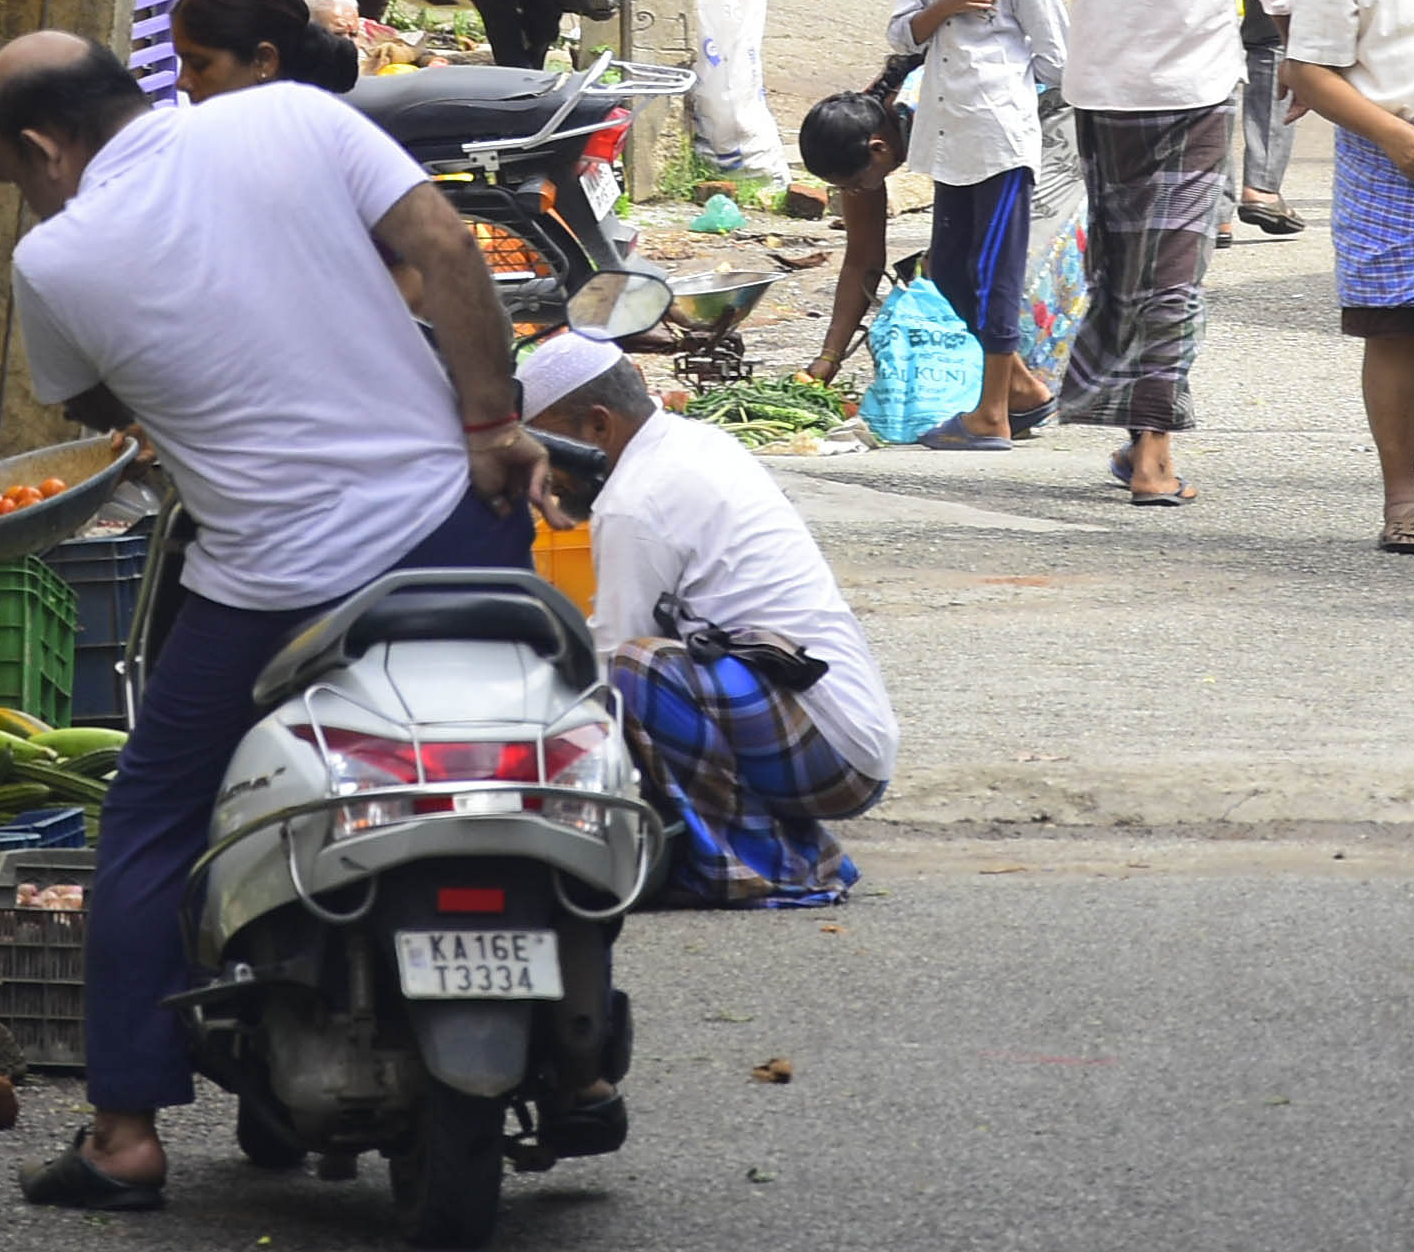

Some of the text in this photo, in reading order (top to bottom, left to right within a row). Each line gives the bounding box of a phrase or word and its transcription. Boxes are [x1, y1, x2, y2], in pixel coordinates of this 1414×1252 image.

[914, 366, 966, 386] KUNJ
[429, 934, 531, 963] KA16E
[434, 964, 534, 992] T3334
